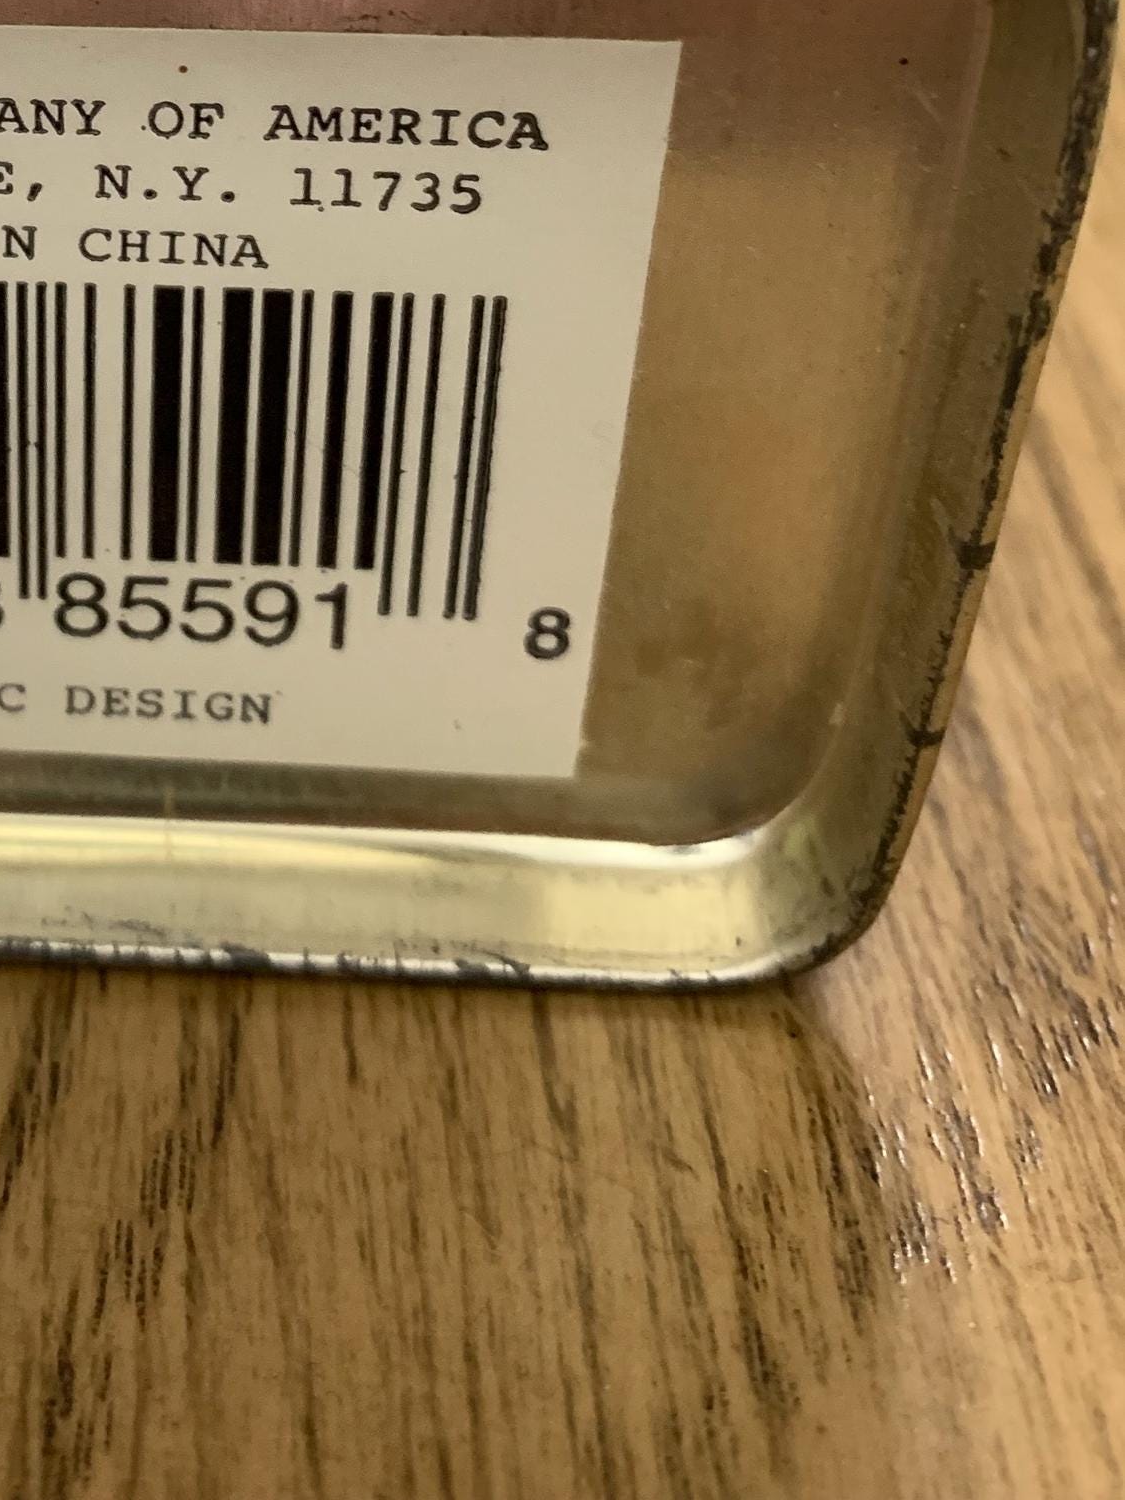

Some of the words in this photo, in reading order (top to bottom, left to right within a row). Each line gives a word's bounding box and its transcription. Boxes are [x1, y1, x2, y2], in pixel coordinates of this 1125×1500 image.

[148, 101, 225, 139] OF
[263, 105, 549, 151] AMERICA
[94, 164, 235, 203] N.Y.
[290, 168, 482, 214] 11735
[78, 228, 269, 269] CHINA
[53, 572, 348, 650] 85591
[524, 607, 571, 661] 8
[65, 686, 271, 724] DESIGN
